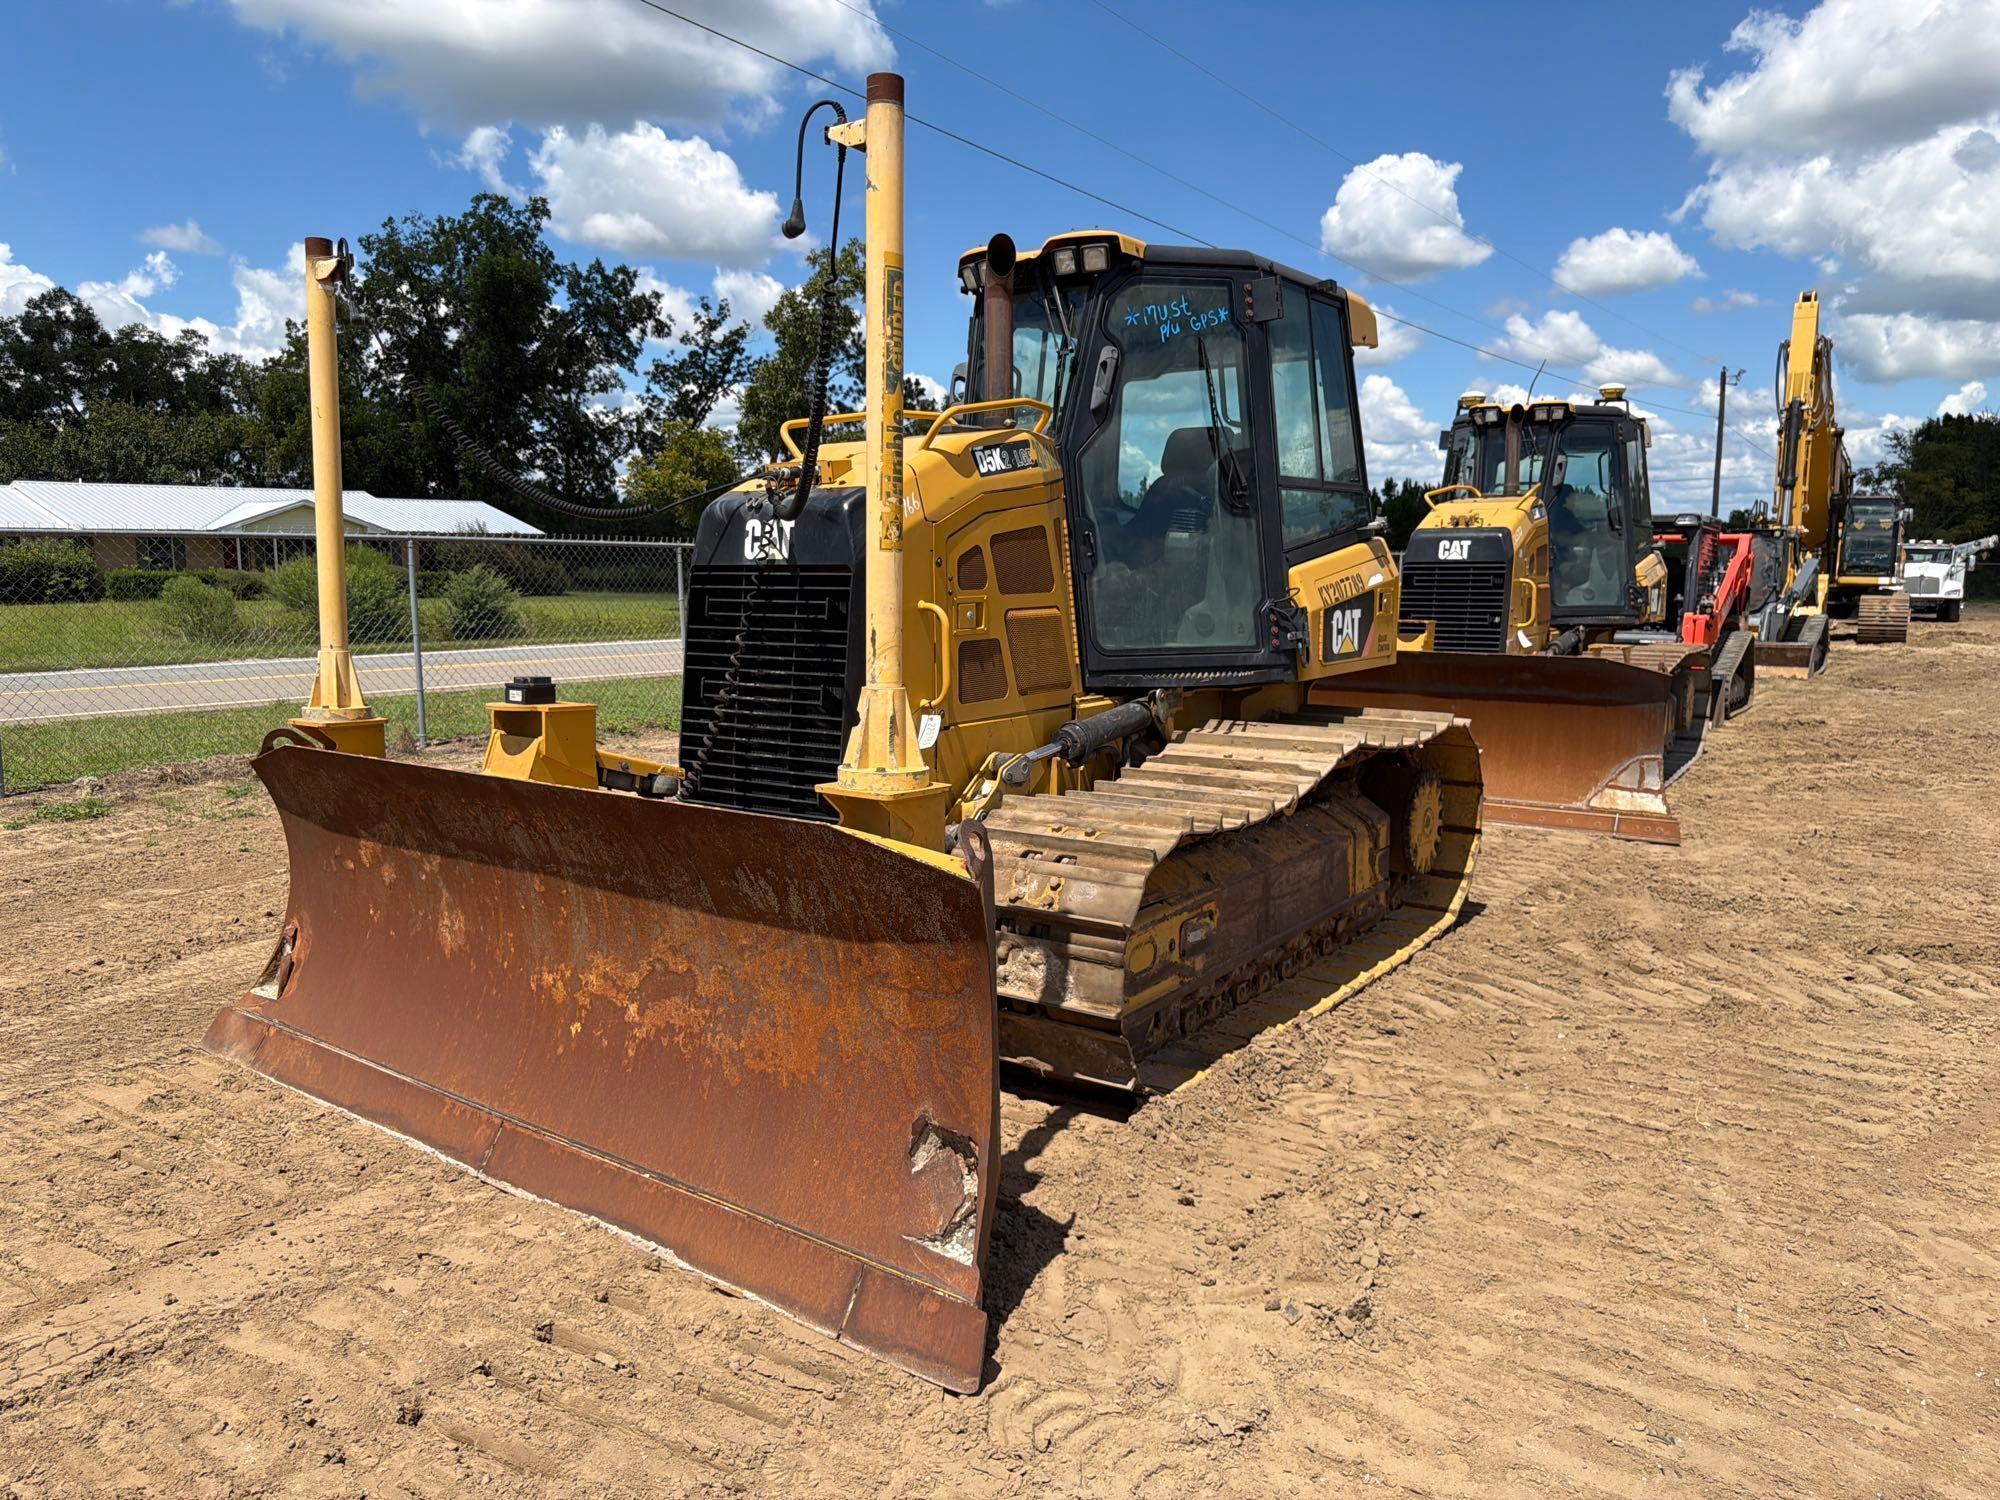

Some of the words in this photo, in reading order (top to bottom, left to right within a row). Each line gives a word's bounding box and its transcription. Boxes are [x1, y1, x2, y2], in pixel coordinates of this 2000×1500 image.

[892, 279, 903, 371] GUIDED
[744, 518, 796, 560] CAT
[1438, 540, 1472, 560] CAT
[1332, 608, 1361, 655] CAT
